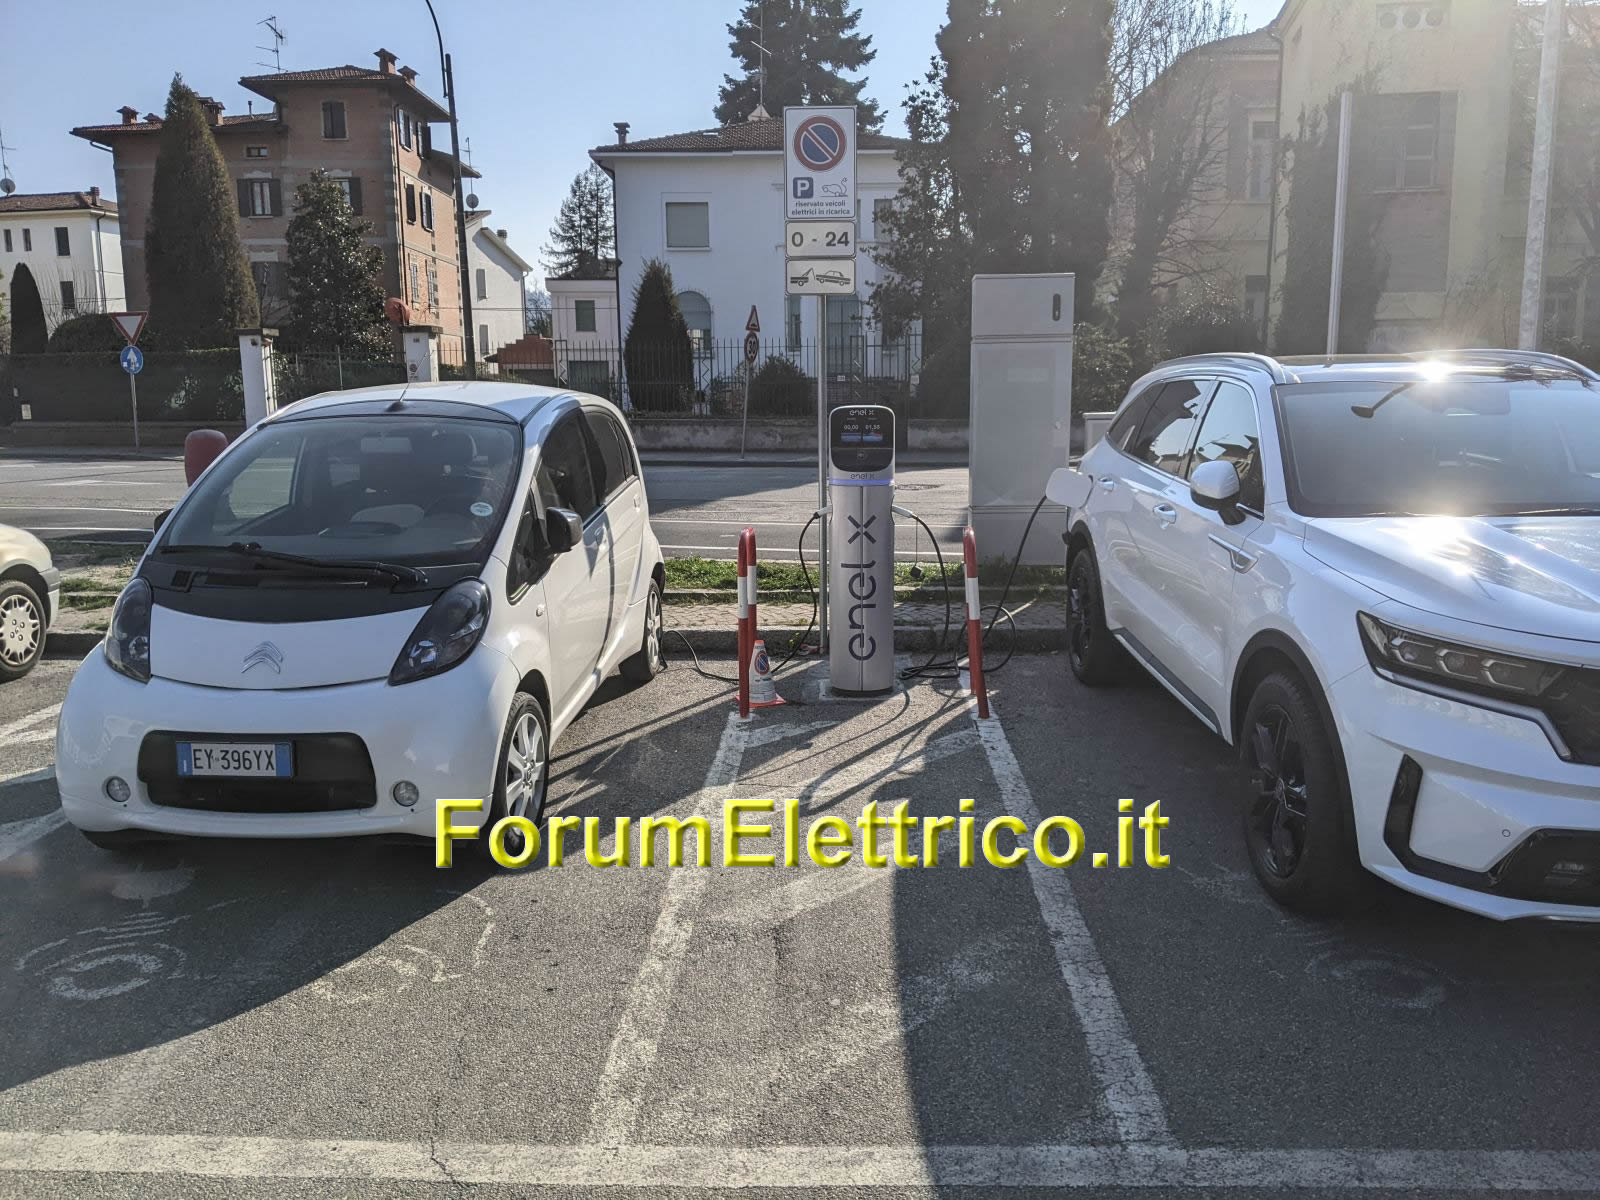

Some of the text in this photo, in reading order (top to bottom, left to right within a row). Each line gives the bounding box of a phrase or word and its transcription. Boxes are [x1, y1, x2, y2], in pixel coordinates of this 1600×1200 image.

[796, 180, 810, 197] P
[795, 200, 824, 208] riservato
[791, 208, 817, 216] elettrici
[791, 231, 804, 248] 0
[825, 231, 850, 247] 24
[849, 408, 867, 416] enel
[841, 560, 877, 661] enel
